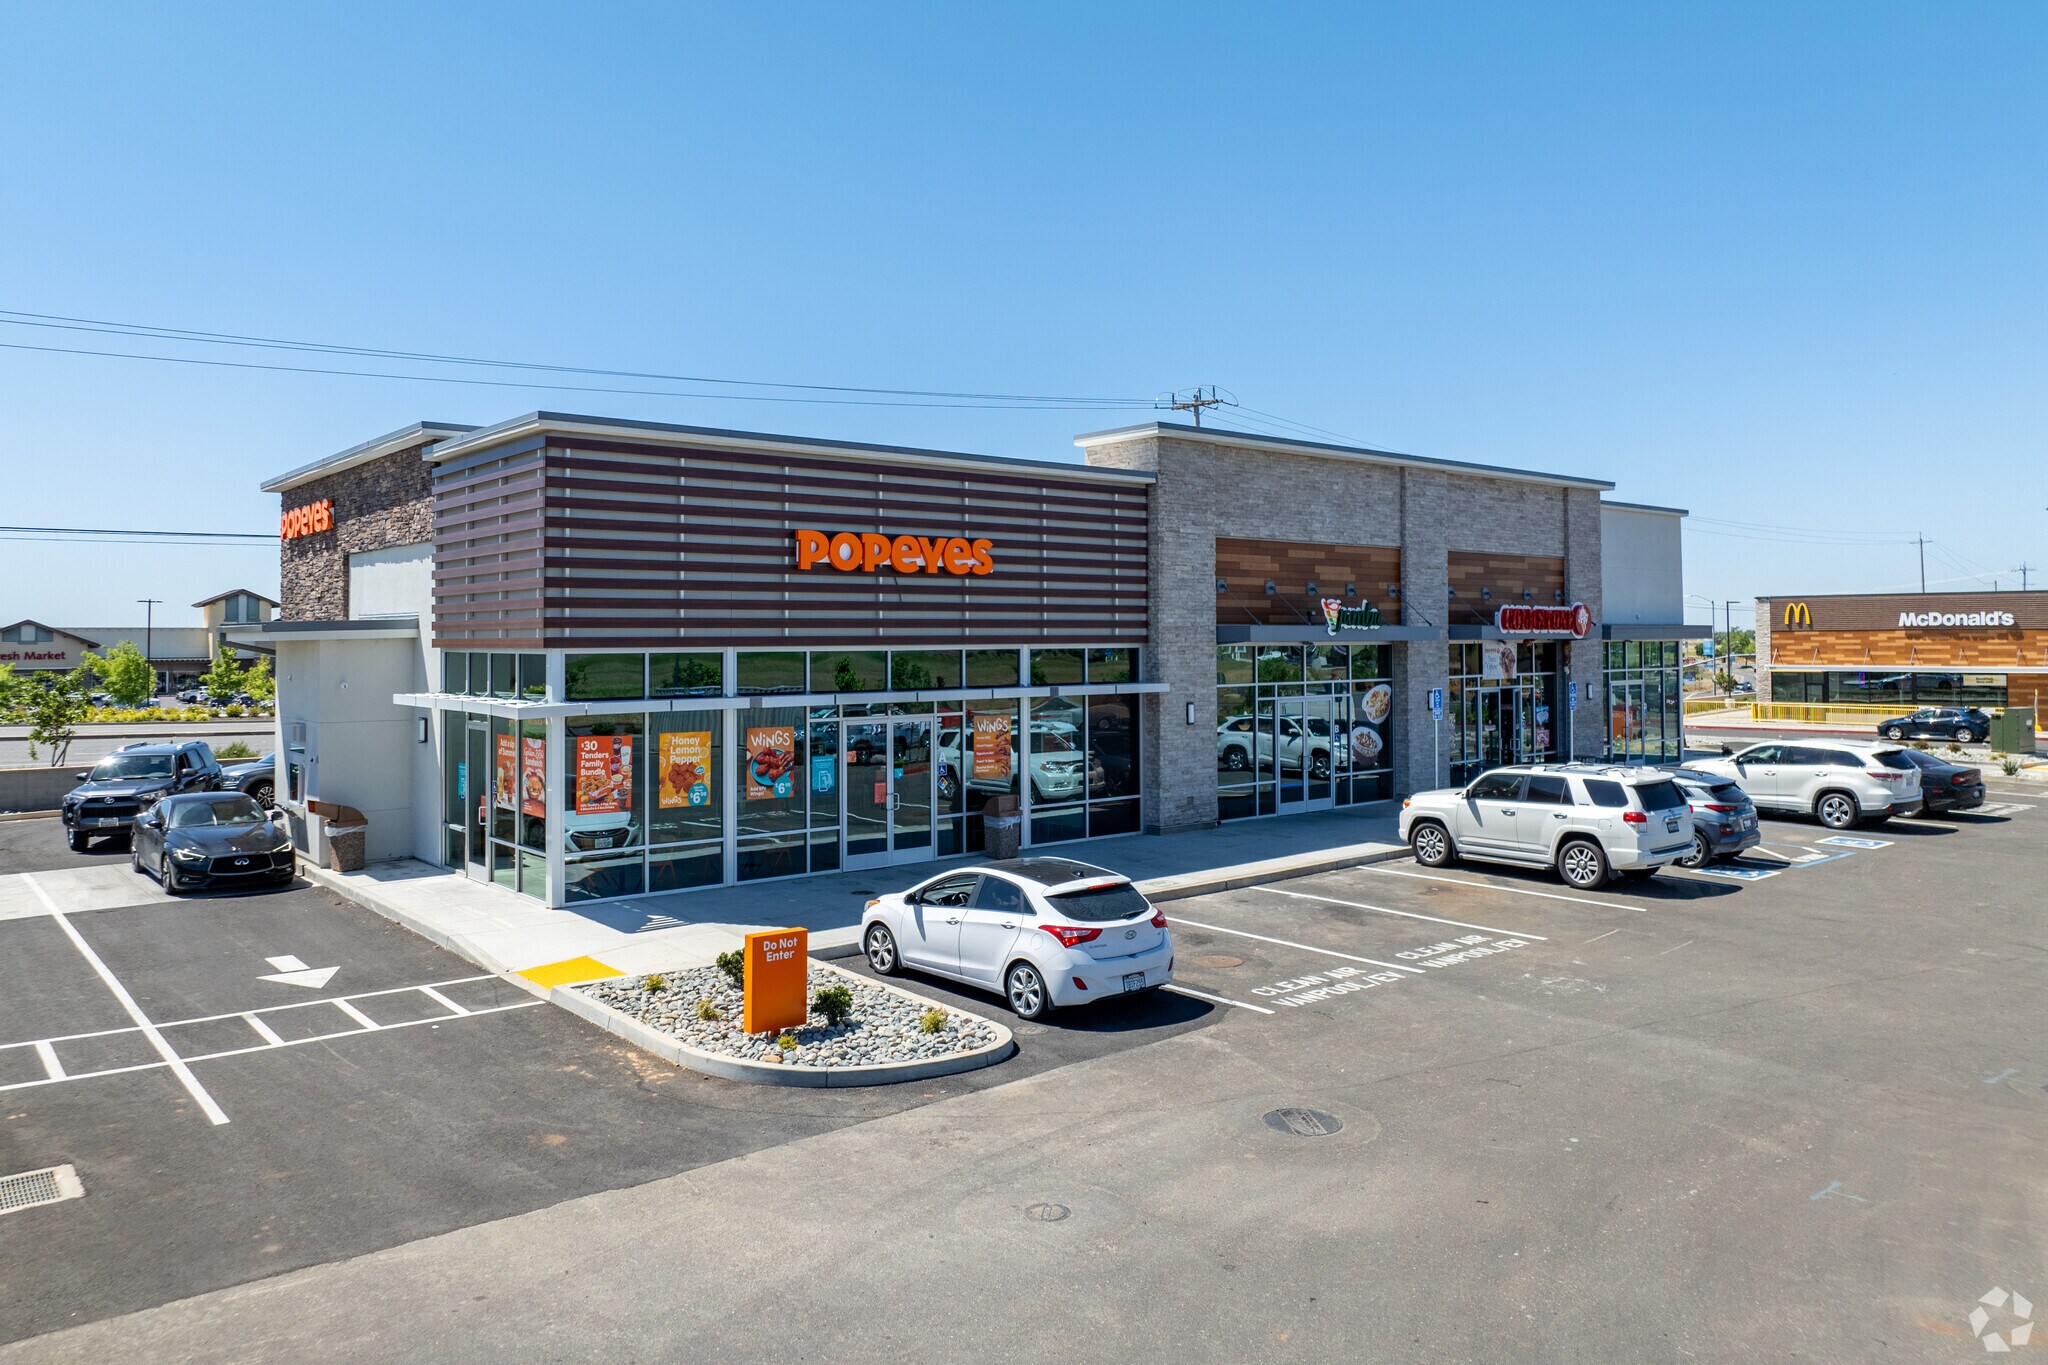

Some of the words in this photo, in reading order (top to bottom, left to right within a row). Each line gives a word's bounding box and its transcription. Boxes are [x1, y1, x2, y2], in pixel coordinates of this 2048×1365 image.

[1898, 611, 2015, 627] McDonald's
[24, 651, 66, 660] Market
[581, 740, 598, 751] $30
[671, 736, 700, 746] Honey
[670, 746, 701, 755] Lemon
[670, 755, 701, 765] Pepper
[939, 752, 947, 762] A
[581, 760, 604, 768] Family
[763, 941, 777, 951] Do
[779, 937, 798, 949] Not
[1395, 942, 1456, 960] CLEAN
[1454, 935, 1493, 946] AIR
[766, 950, 795, 962] Enter
[1417, 938, 1530, 969] VANPOOL/EV
[1251, 975, 1329, 996] CLEAN
[1324, 966, 1367, 981] AIR
[1271, 971, 1406, 1008] VANPOOL/EV
